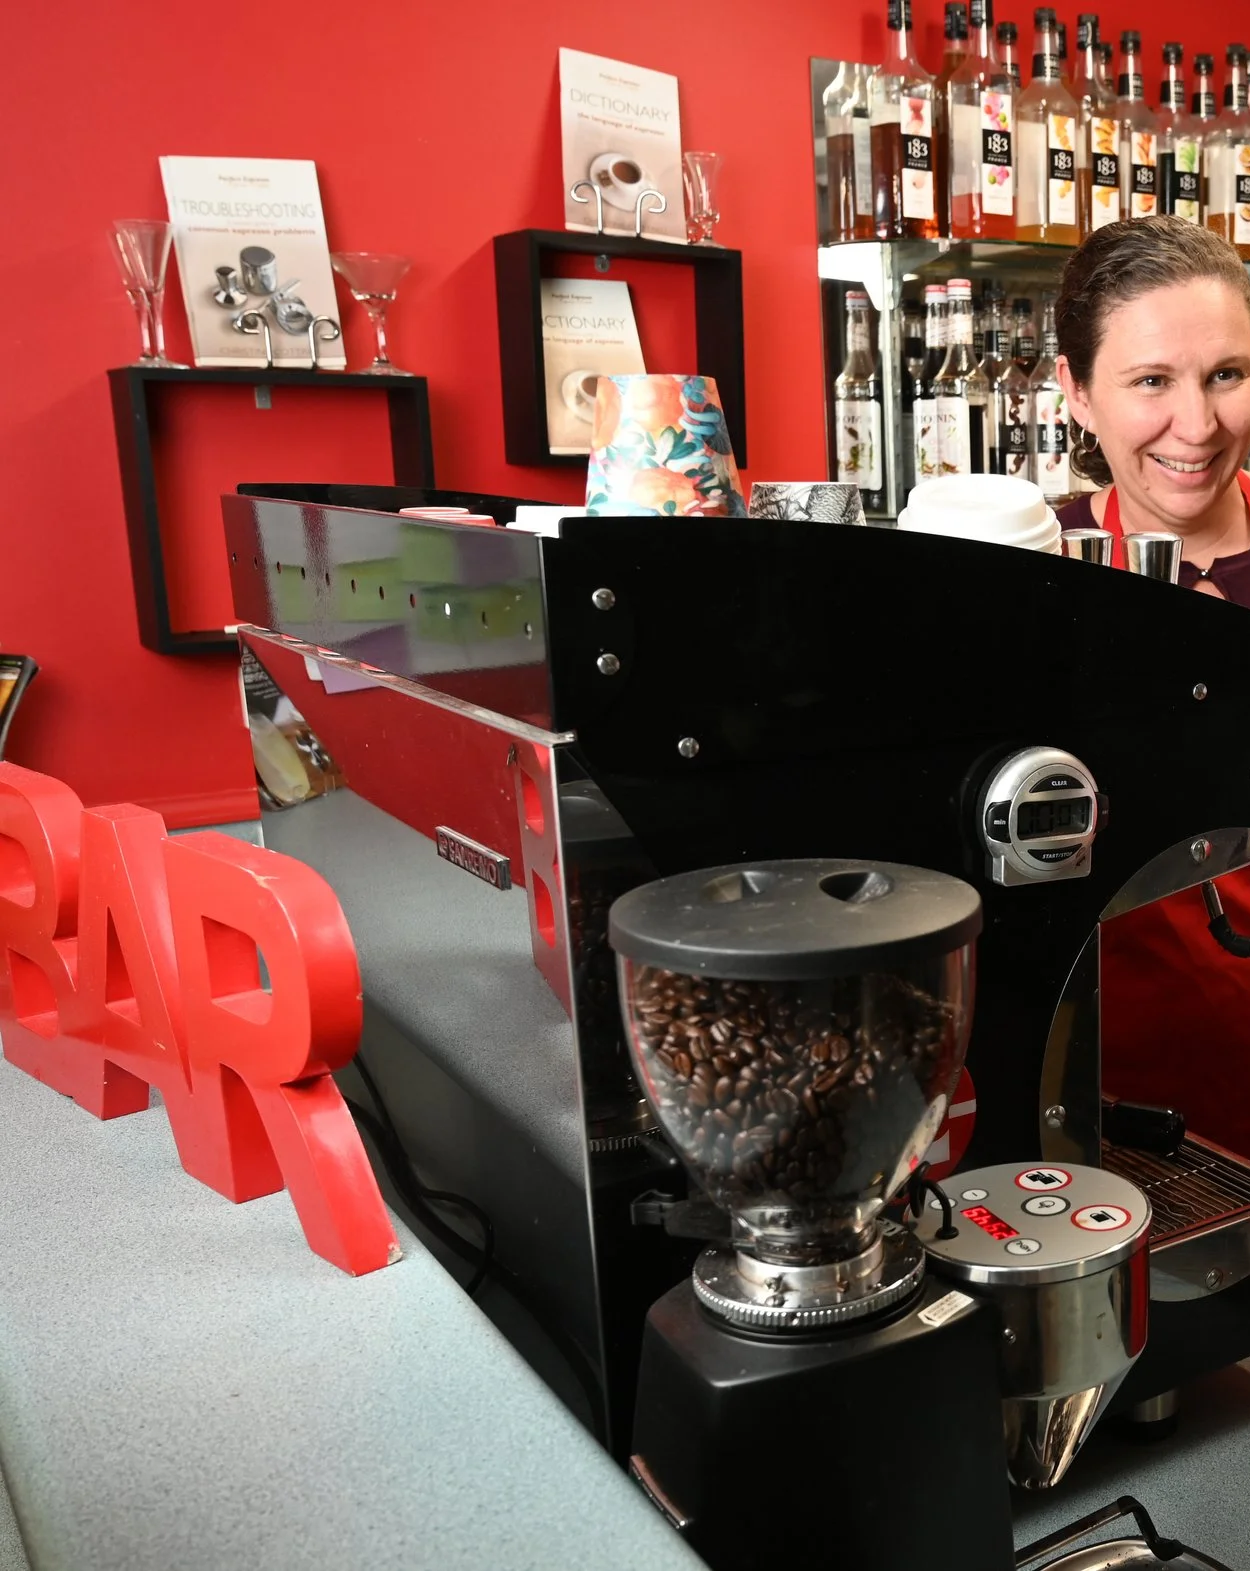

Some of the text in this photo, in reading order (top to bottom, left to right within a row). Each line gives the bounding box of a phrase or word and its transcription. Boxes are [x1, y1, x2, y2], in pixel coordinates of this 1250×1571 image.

[569, 87, 671, 122] DICTIONARY
[181, 199, 316, 219] TROUBLESHOOTING
[232, 227, 271, 235] espresso
[273, 228, 316, 236] problems
[544, 314, 627, 330] CTIONARY
